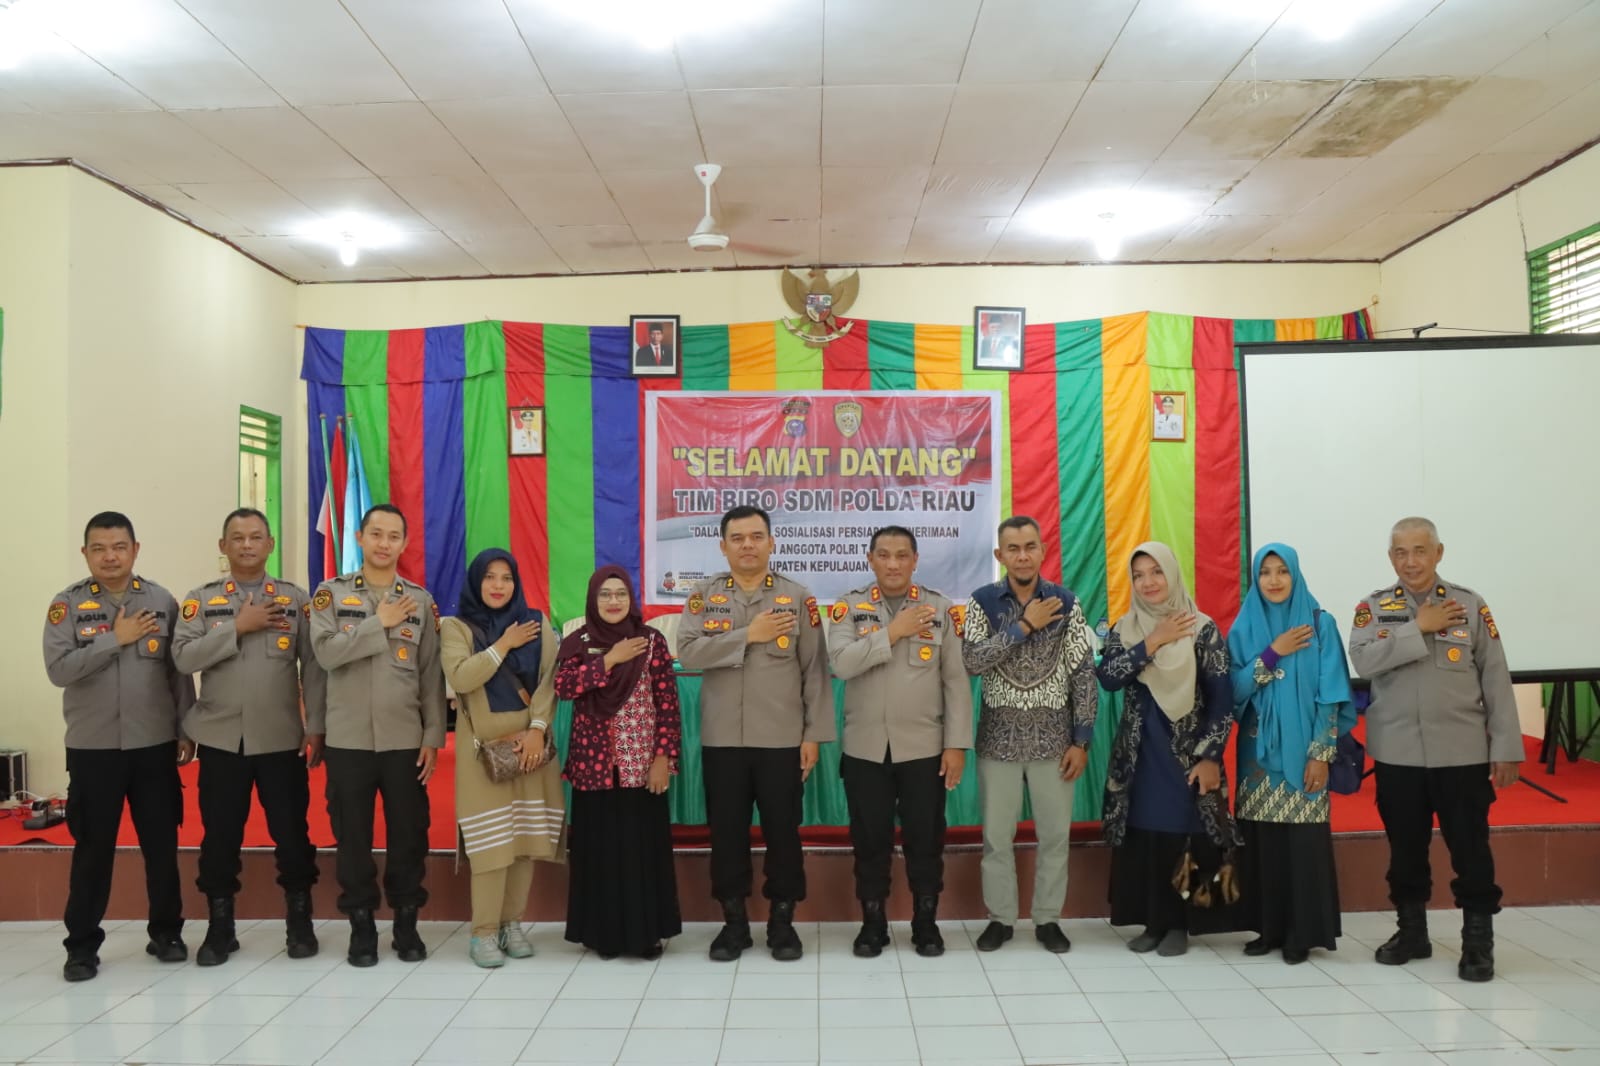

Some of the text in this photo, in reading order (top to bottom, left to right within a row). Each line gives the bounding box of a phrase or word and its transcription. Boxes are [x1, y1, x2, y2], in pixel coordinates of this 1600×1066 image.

[673, 446, 977, 478] "SELAMAT DATANG"
[674, 489, 977, 513] TIM BIRO SDM POLDA RIAU
[689, 525, 722, 538] "DALA
[774, 526, 836, 538] SOSIALISASI
[838, 526, 880, 538] PERSIAP
[779, 543, 827, 555] ANGGOTA
[829, 543, 859, 555] POLRI
[769, 560, 870, 573] UPATEN KEPULAUAN
